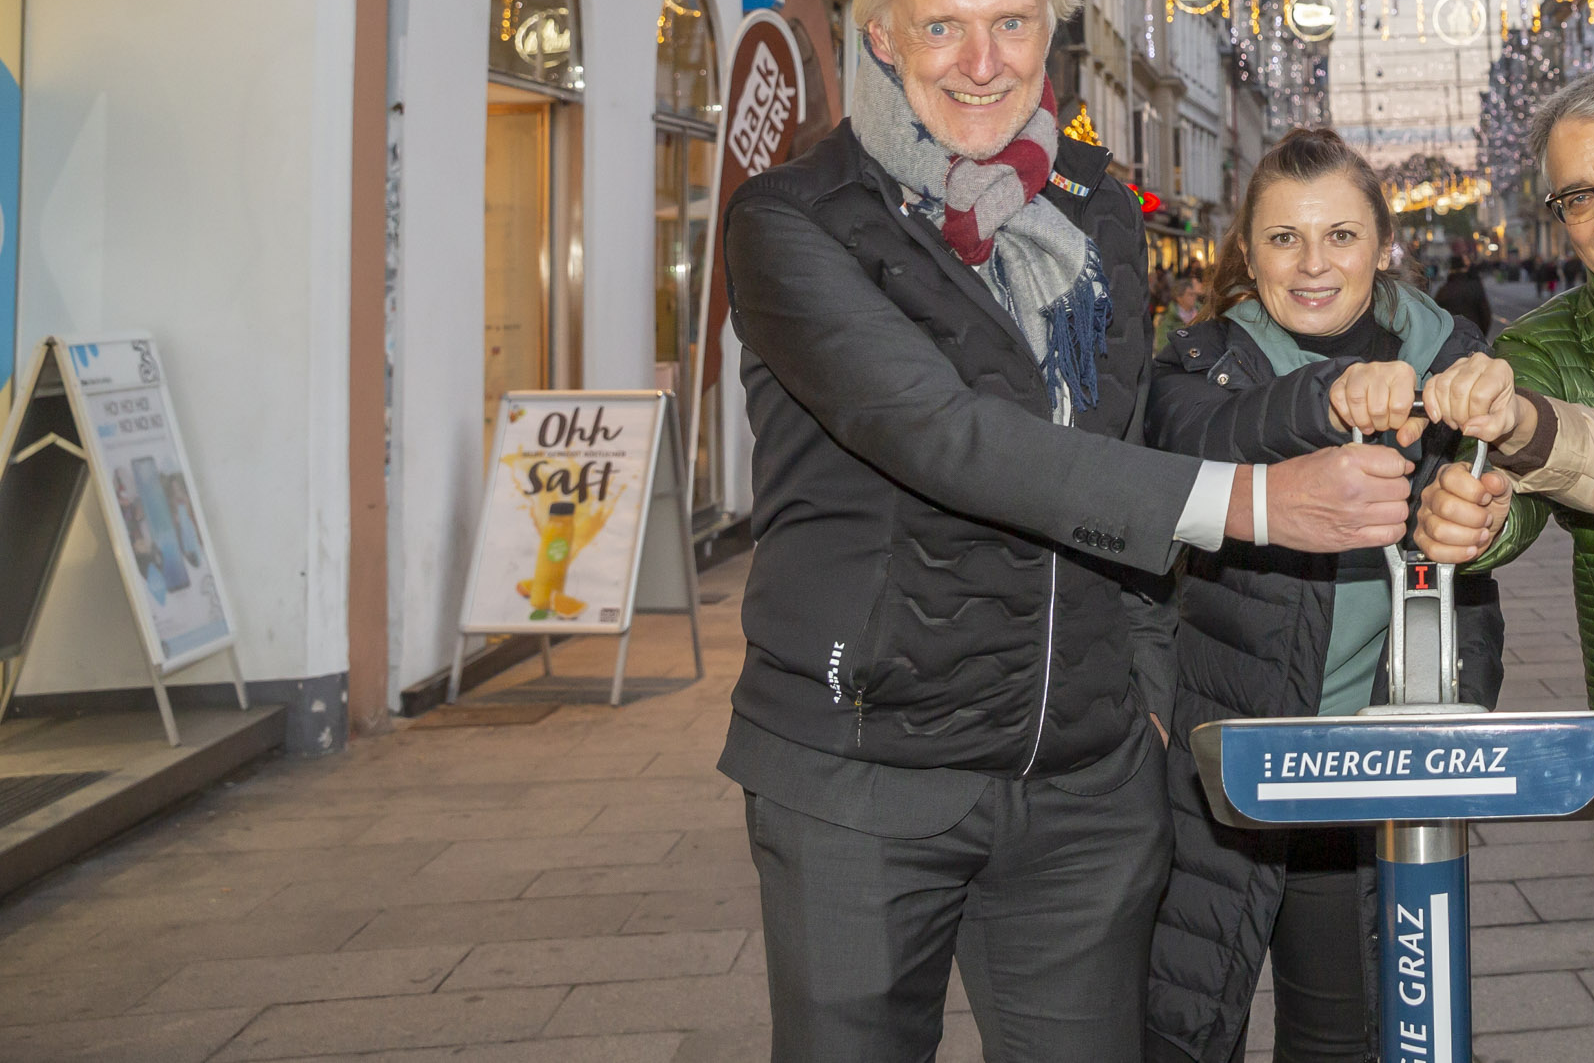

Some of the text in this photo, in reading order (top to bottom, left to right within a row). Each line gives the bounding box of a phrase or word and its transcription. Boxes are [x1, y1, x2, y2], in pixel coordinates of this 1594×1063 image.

[734, 58, 775, 154] back
[747, 73, 796, 177] WERK
[537, 406, 623, 448] Ohh
[1280, 746, 1509, 778] ENERGIE GRAZ
[1397, 903, 1426, 1007] GRAZ
